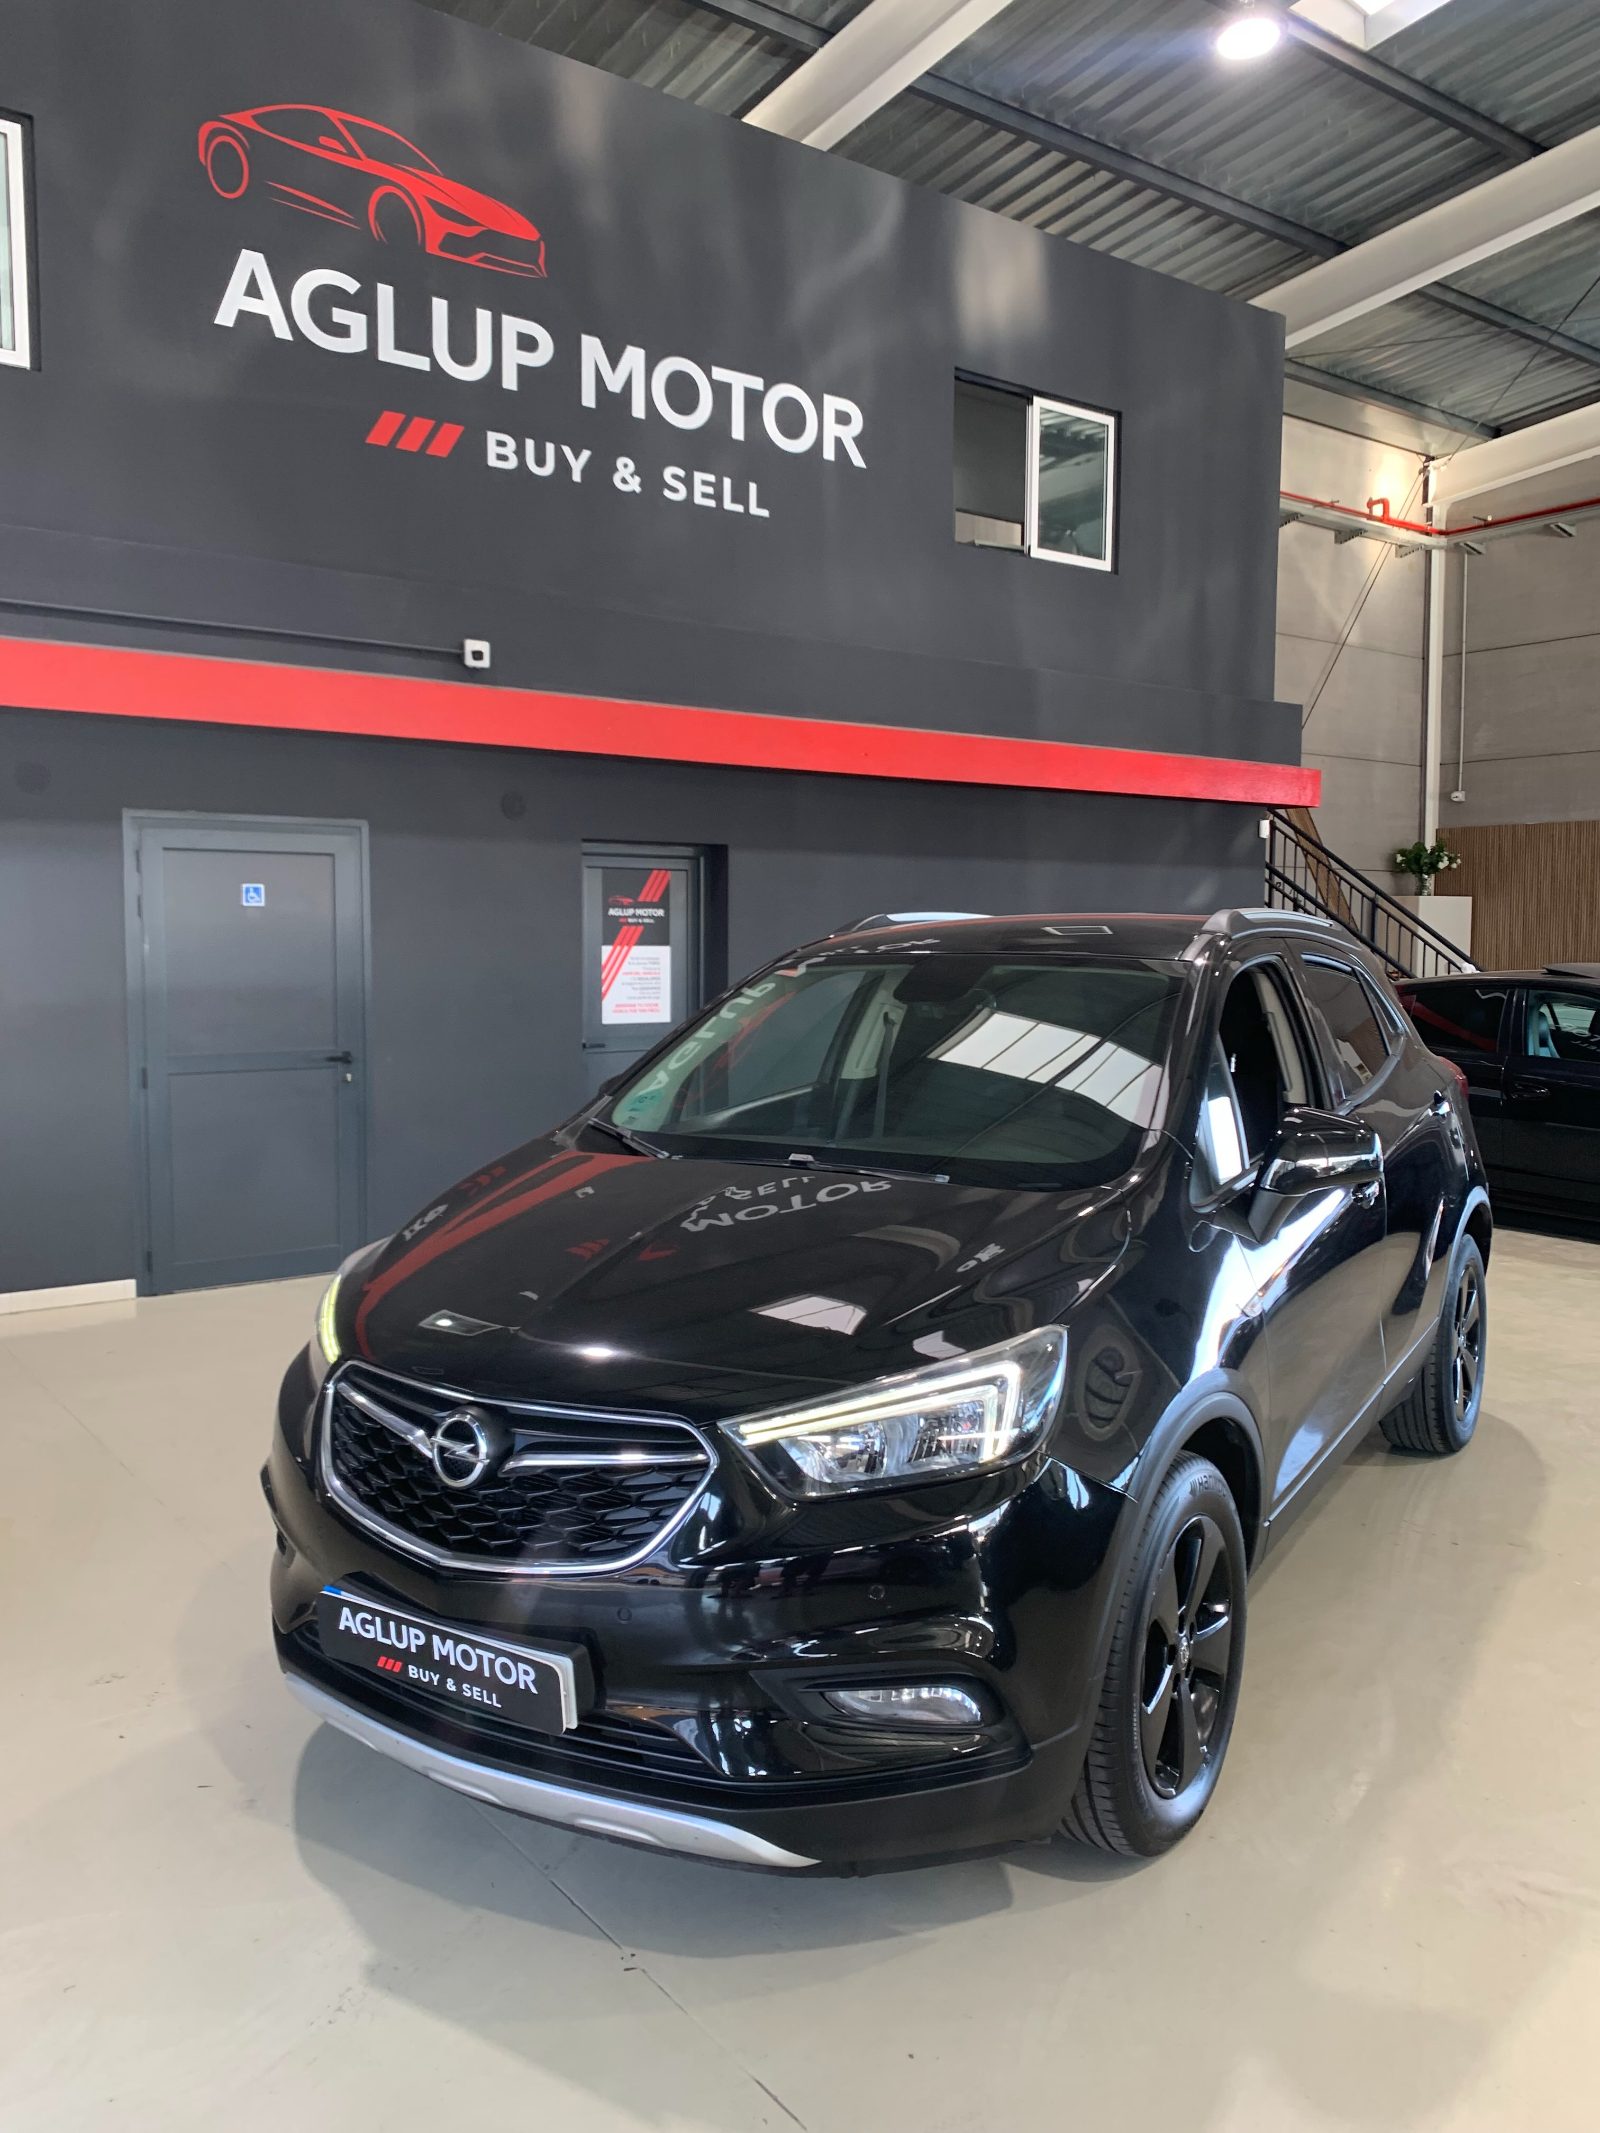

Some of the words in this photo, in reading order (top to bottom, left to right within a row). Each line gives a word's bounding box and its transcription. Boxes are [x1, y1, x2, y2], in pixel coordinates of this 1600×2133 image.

[213, 248, 555, 391] AGLUP
[580, 333, 867, 469] MOTOR
[486, 430, 592, 483] BUY
[612, 456, 642, 494] &
[662, 465, 770, 518] SELL
[608, 908, 634, 917] AGLUP
[635, 908, 665, 917] MOTOR
[338, 1607, 426, 1653] AGLUP
[432, 1634, 538, 1695] MOTOR
[407, 1665, 440, 1686] BUY
[446, 1678, 457, 1692] &
[462, 1683, 502, 1708] SELL
